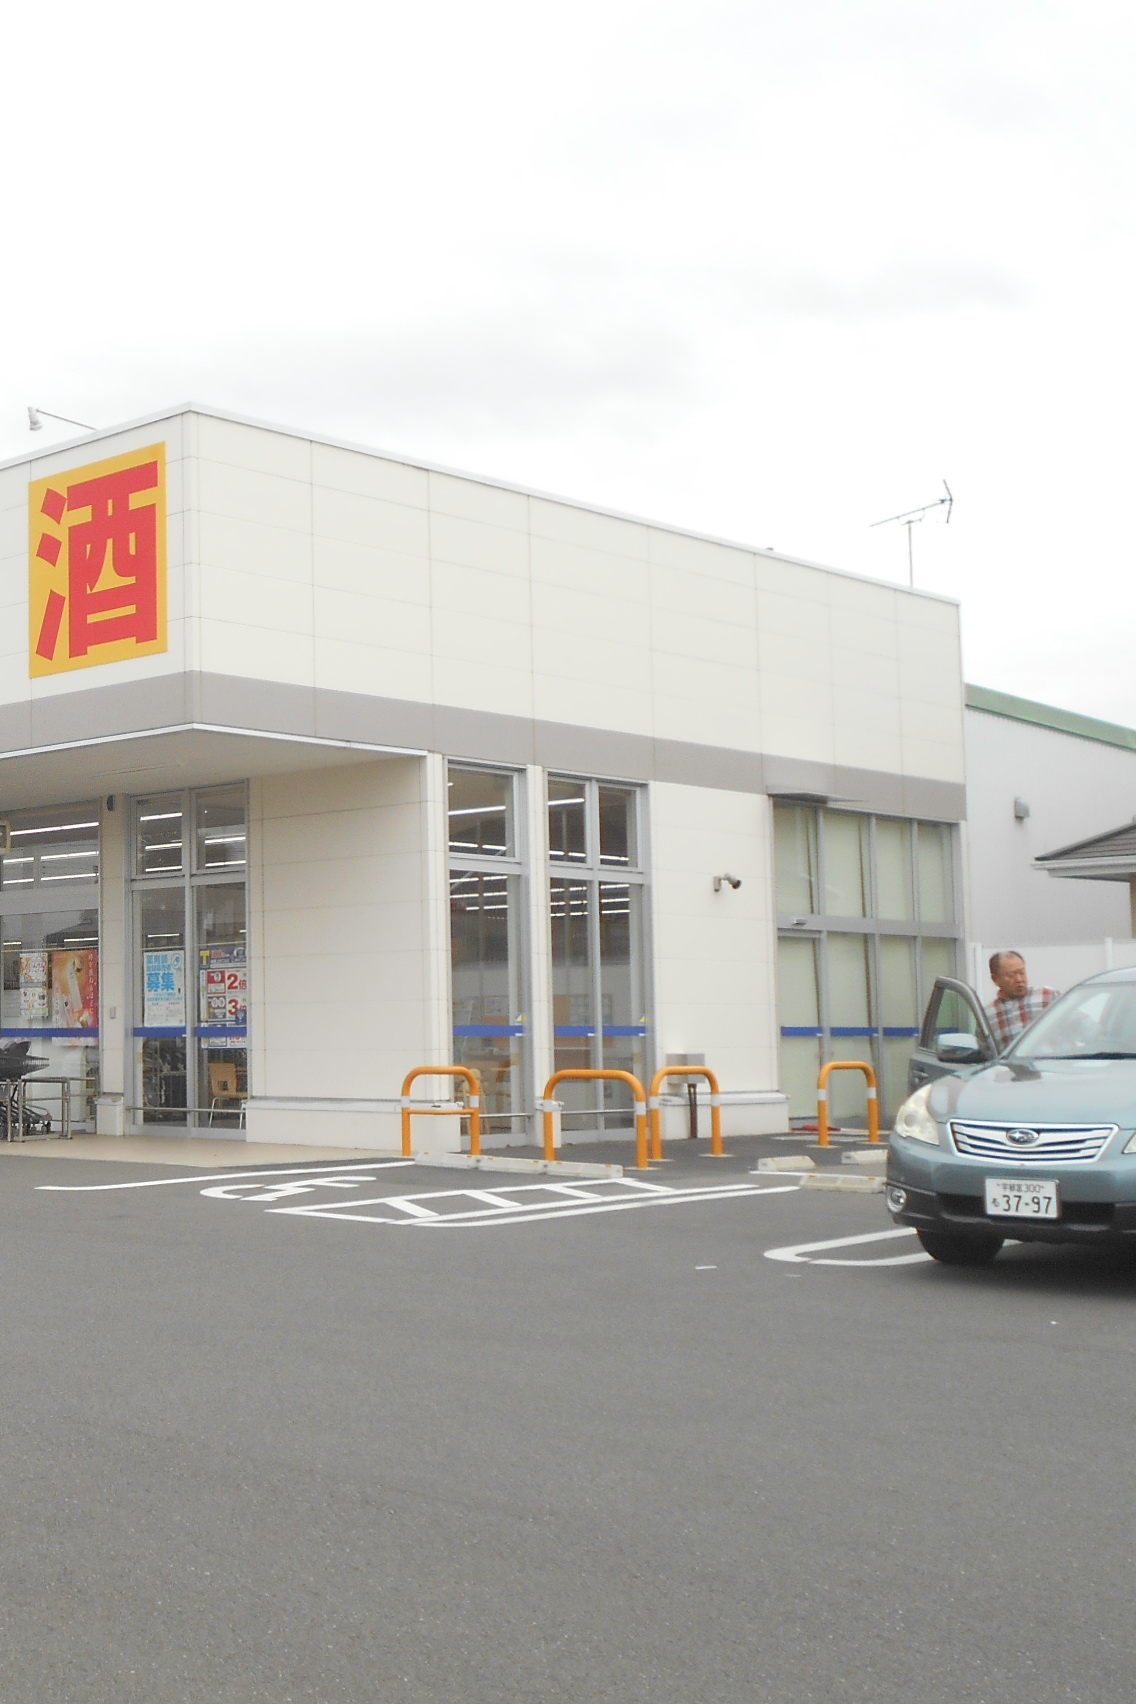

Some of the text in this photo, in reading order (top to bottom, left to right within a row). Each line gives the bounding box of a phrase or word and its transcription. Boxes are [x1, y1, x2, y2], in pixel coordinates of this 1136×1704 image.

[35, 459, 159, 662] 酒
[147, 972, 174, 992] 募集
[1002, 1194, 1053, 1215] 37-97
